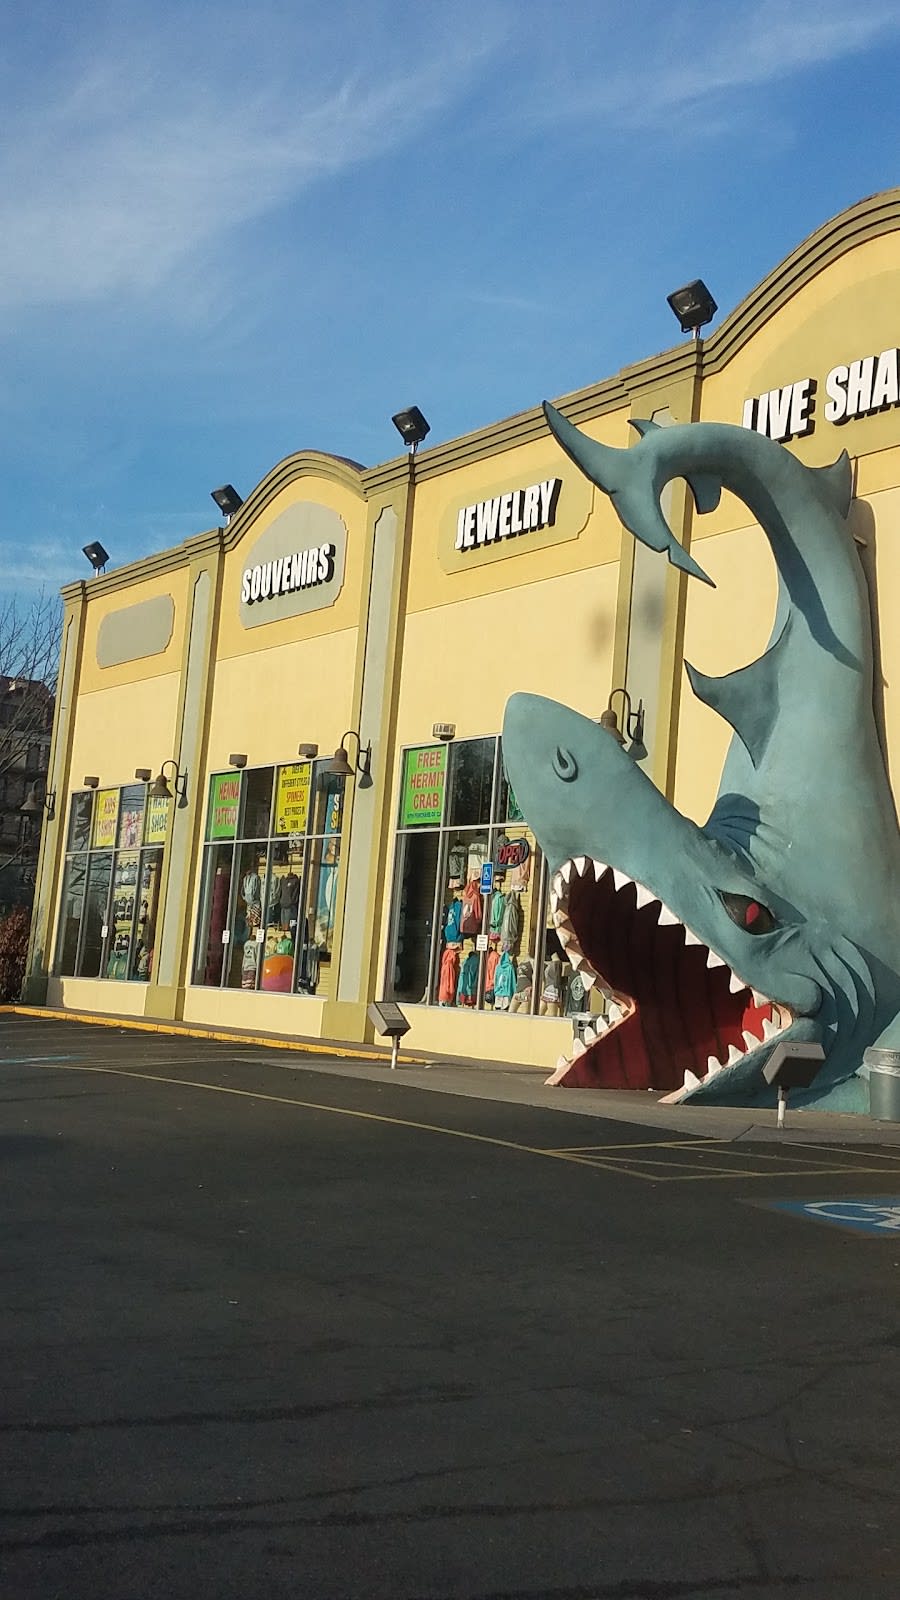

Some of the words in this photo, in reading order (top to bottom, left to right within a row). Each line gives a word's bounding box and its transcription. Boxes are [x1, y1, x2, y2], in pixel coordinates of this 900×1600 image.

[454, 478, 560, 551] JEWELRY
[241, 543, 333, 603] SOUVENIRS
[417, 751, 442, 769] FREE
[410, 771, 445, 789] HERMIT
[413, 792, 440, 810] CRAB
[498, 845, 525, 864] OPEN
